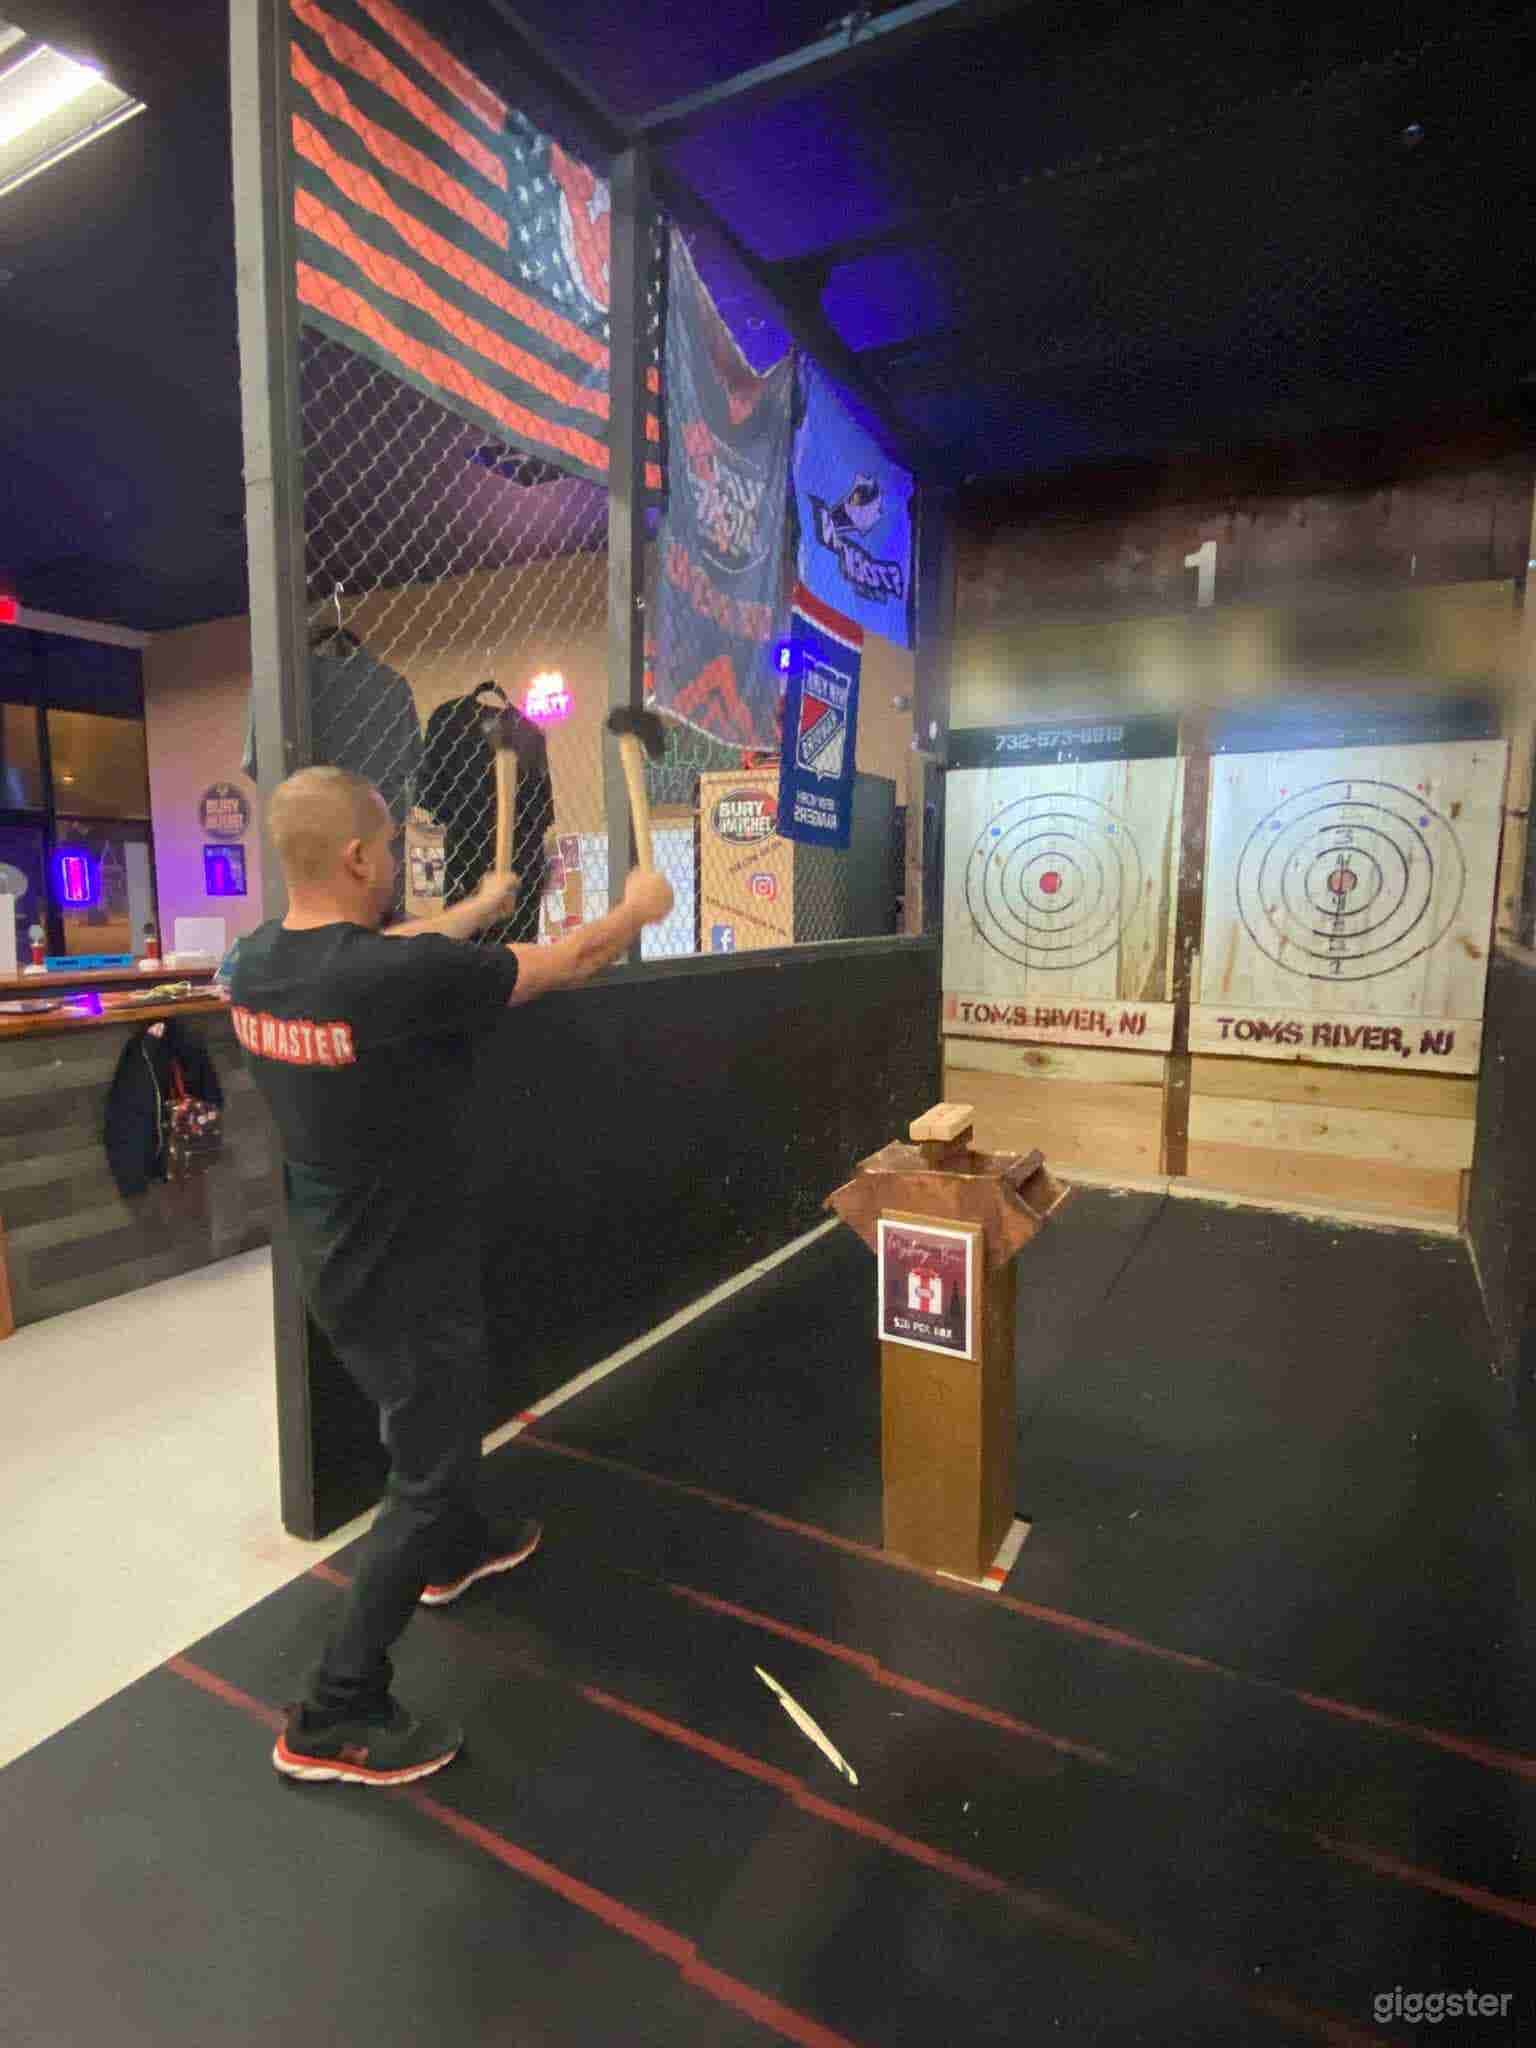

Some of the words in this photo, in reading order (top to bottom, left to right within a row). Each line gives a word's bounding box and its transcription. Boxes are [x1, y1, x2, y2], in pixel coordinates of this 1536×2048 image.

[1184, 541, 1217, 608] 1
[720, 800, 763, 817] BURY
[262, 1018, 353, 1061] MASTER
[961, 1002, 1028, 1027] TOMS
[1034, 1007, 1112, 1038] RIVER,
[1119, 1011, 1148, 1036] NJ
[1217, 1017, 1304, 1045] TOMS
[1311, 1021, 1411, 1058] RIVER,
[1420, 1029, 1455, 1056] NJ
